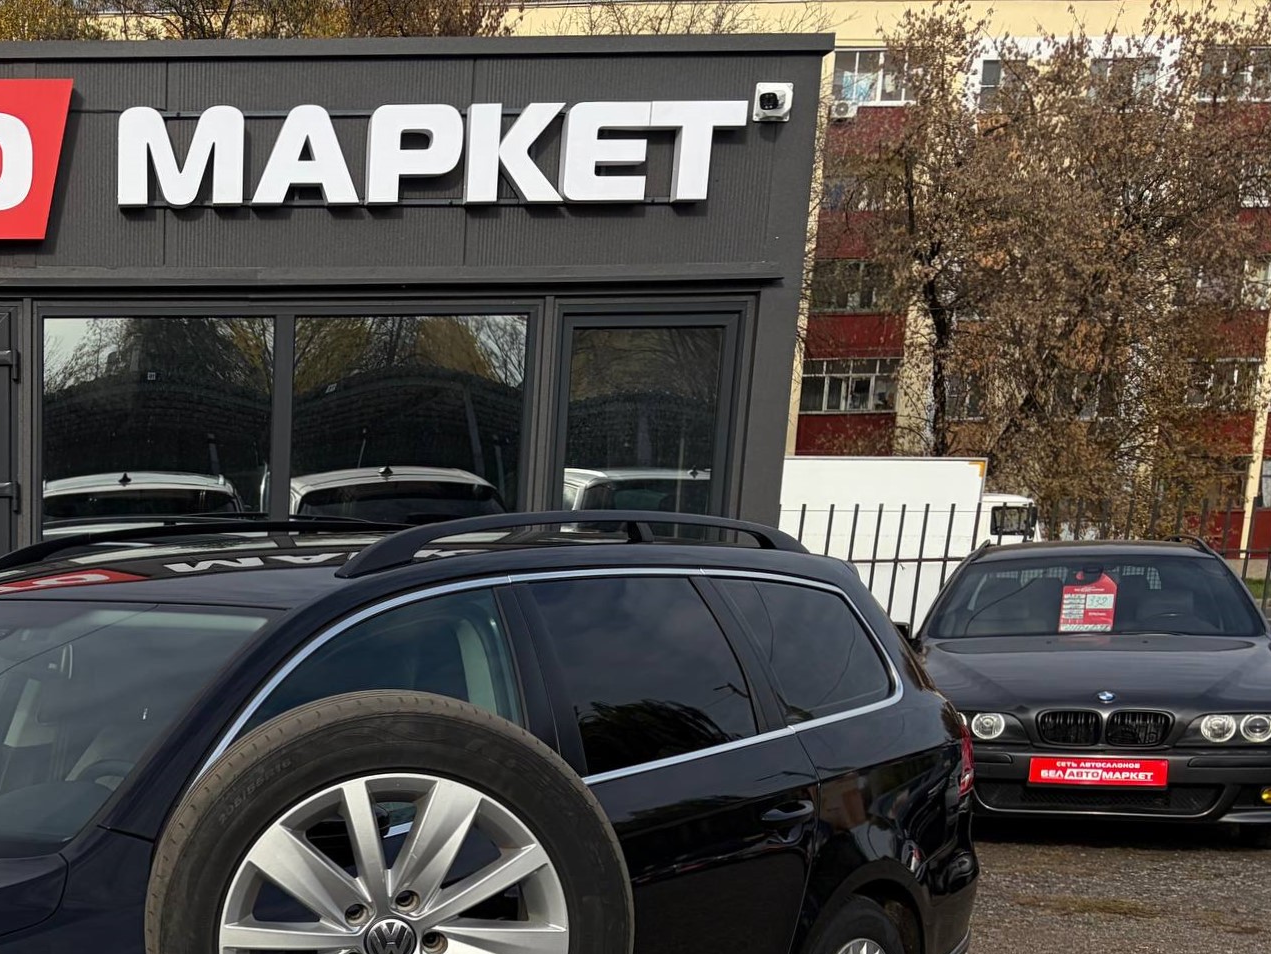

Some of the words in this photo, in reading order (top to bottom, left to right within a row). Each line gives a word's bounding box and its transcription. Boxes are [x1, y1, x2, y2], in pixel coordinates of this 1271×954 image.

[117, 100, 749, 207] МАРКЕТ
[1040, 769, 1064, 779] БЕЛ
[1066, 770, 1100, 778] АВТО
[1102, 770, 1154, 780] МАРКЕТ
